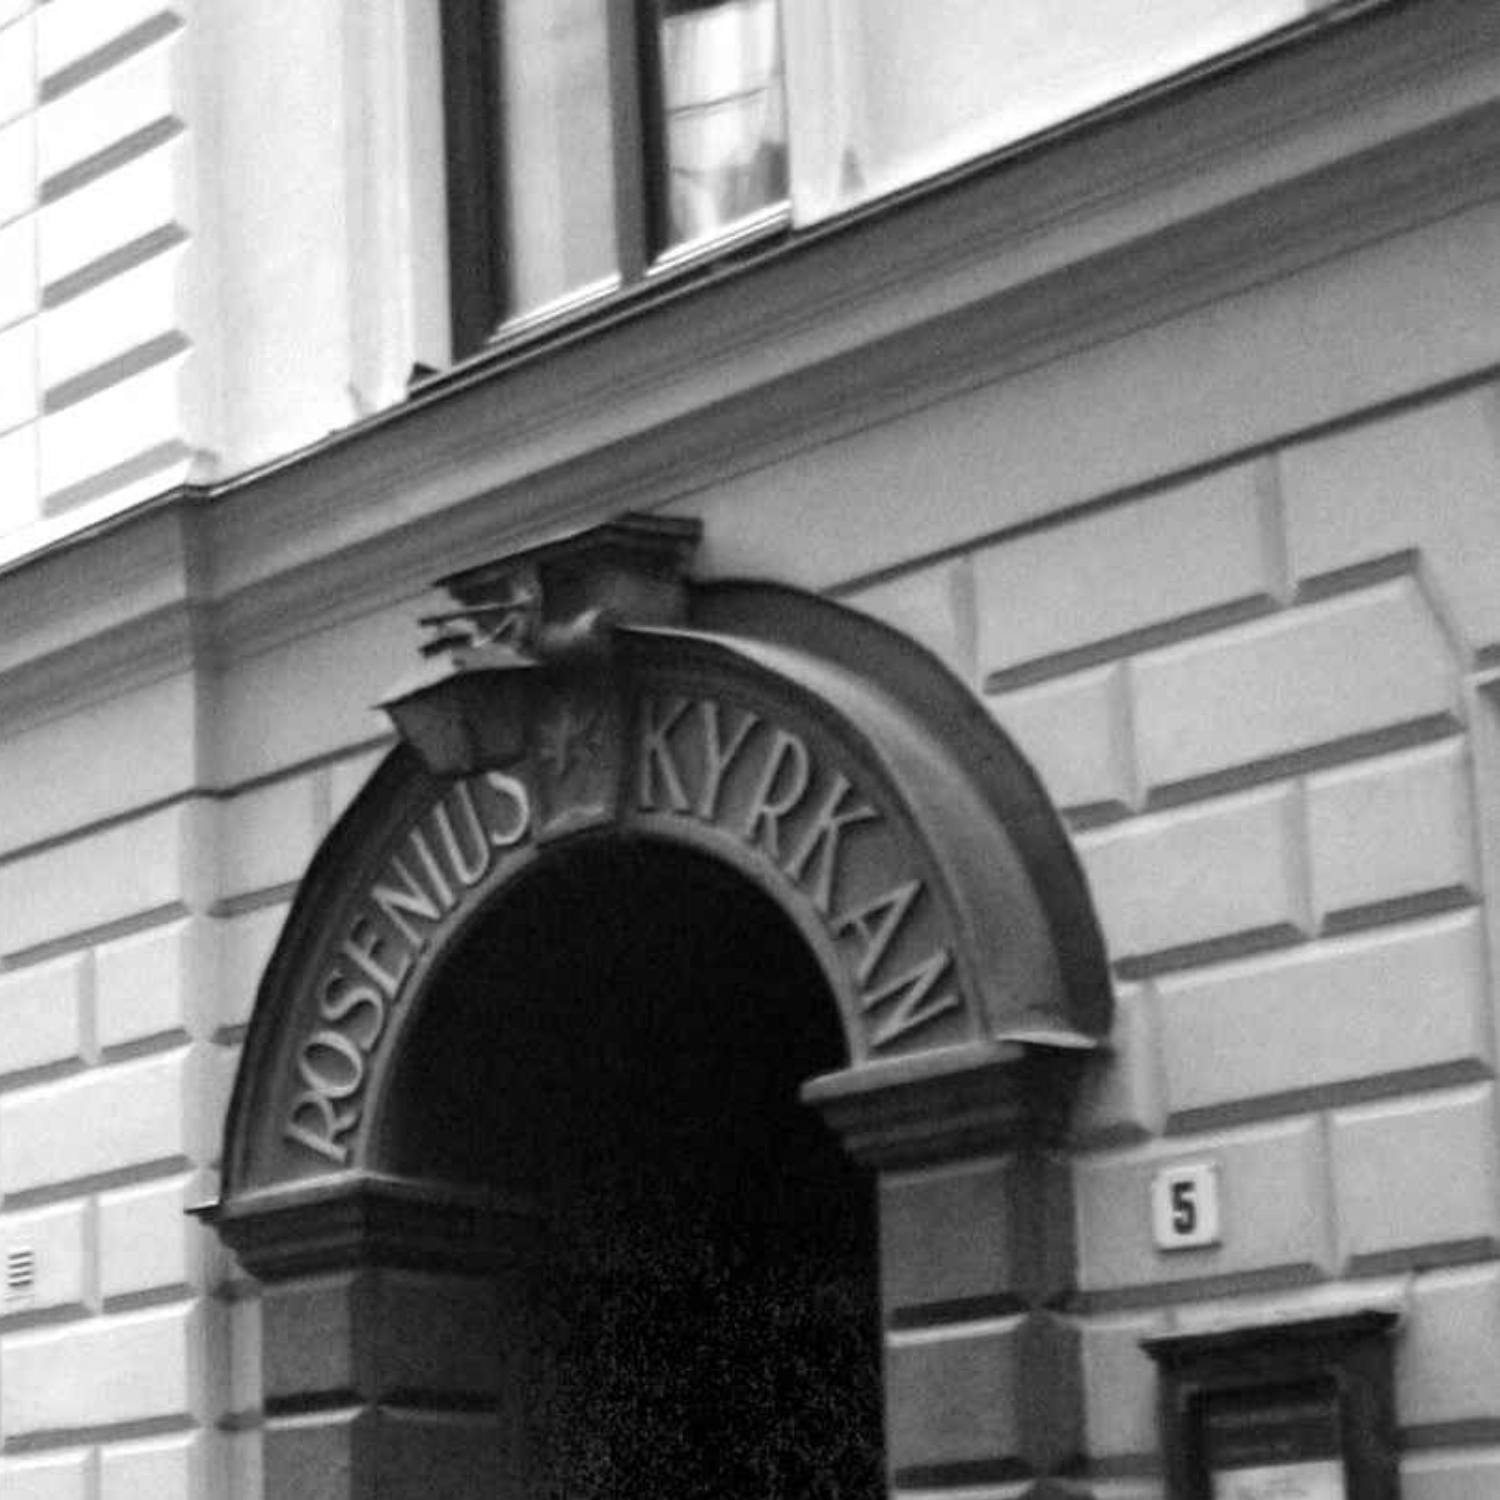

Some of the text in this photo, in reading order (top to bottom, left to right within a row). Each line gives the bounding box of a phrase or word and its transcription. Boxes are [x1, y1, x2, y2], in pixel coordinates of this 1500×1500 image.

[285, 697, 960, 1163] ROSENIUS KYRKAN
[1172, 1181, 1197, 1235] 5
